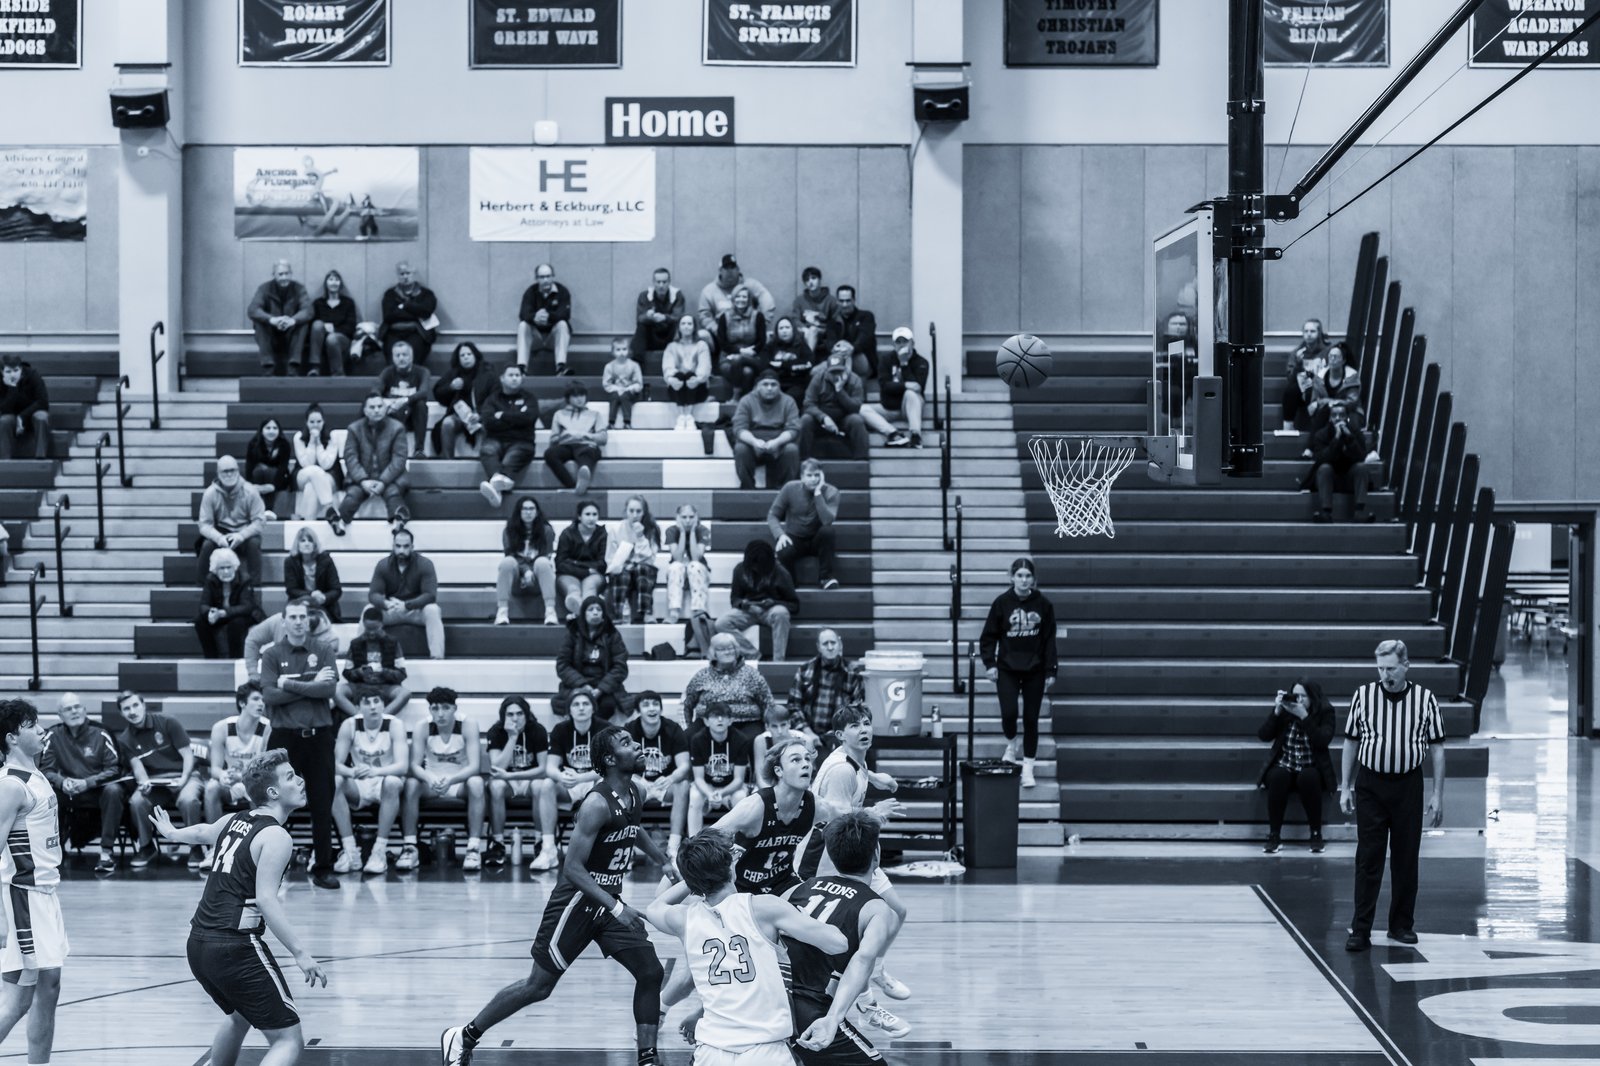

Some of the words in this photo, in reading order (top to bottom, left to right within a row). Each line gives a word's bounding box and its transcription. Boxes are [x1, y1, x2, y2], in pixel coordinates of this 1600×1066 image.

[283, 5, 346, 21] ROSARY
[729, 4, 755, 20] ST.
[760, 5, 831, 20] FRANCIS
[1508, 0, 1585, 11] WHEATON
[496, 8, 521, 23] ST.
[528, 8, 596, 23] EDWARD
[1281, 7, 1345, 21] FENTON
[1036, 18, 1126, 32] CHRISTIAN
[1508, 18, 1584, 33] ACADEMY
[285, 28, 345, 44] ROYALS
[494, 30, 549, 45] GREEN
[555, 30, 598, 45] WAVE
[738, 27, 821, 43] SPARTANS
[1045, 40, 1117, 54] TROJANS
[612, 103, 728, 137] Home
[256, 168, 298, 177] ANCHOR
[539, 160, 587, 192] HE
[264, 179, 317, 188] PLUMBING
[480, 201, 535, 212] Herbert
[540, 202, 549, 212] &
[555, 201, 613, 214] Eckburg,
[617, 201, 645, 212] LLC
[520, 218, 569, 229] Attorneys
[573, 219, 582, 227] at
[586, 218, 605, 227] Law
[887, 681, 906, 701] G
[607, 847, 633, 871] 23
[811, 880, 858, 899] LIONS
[797, 894, 842, 924] 11
[702, 934, 756, 985] 23
